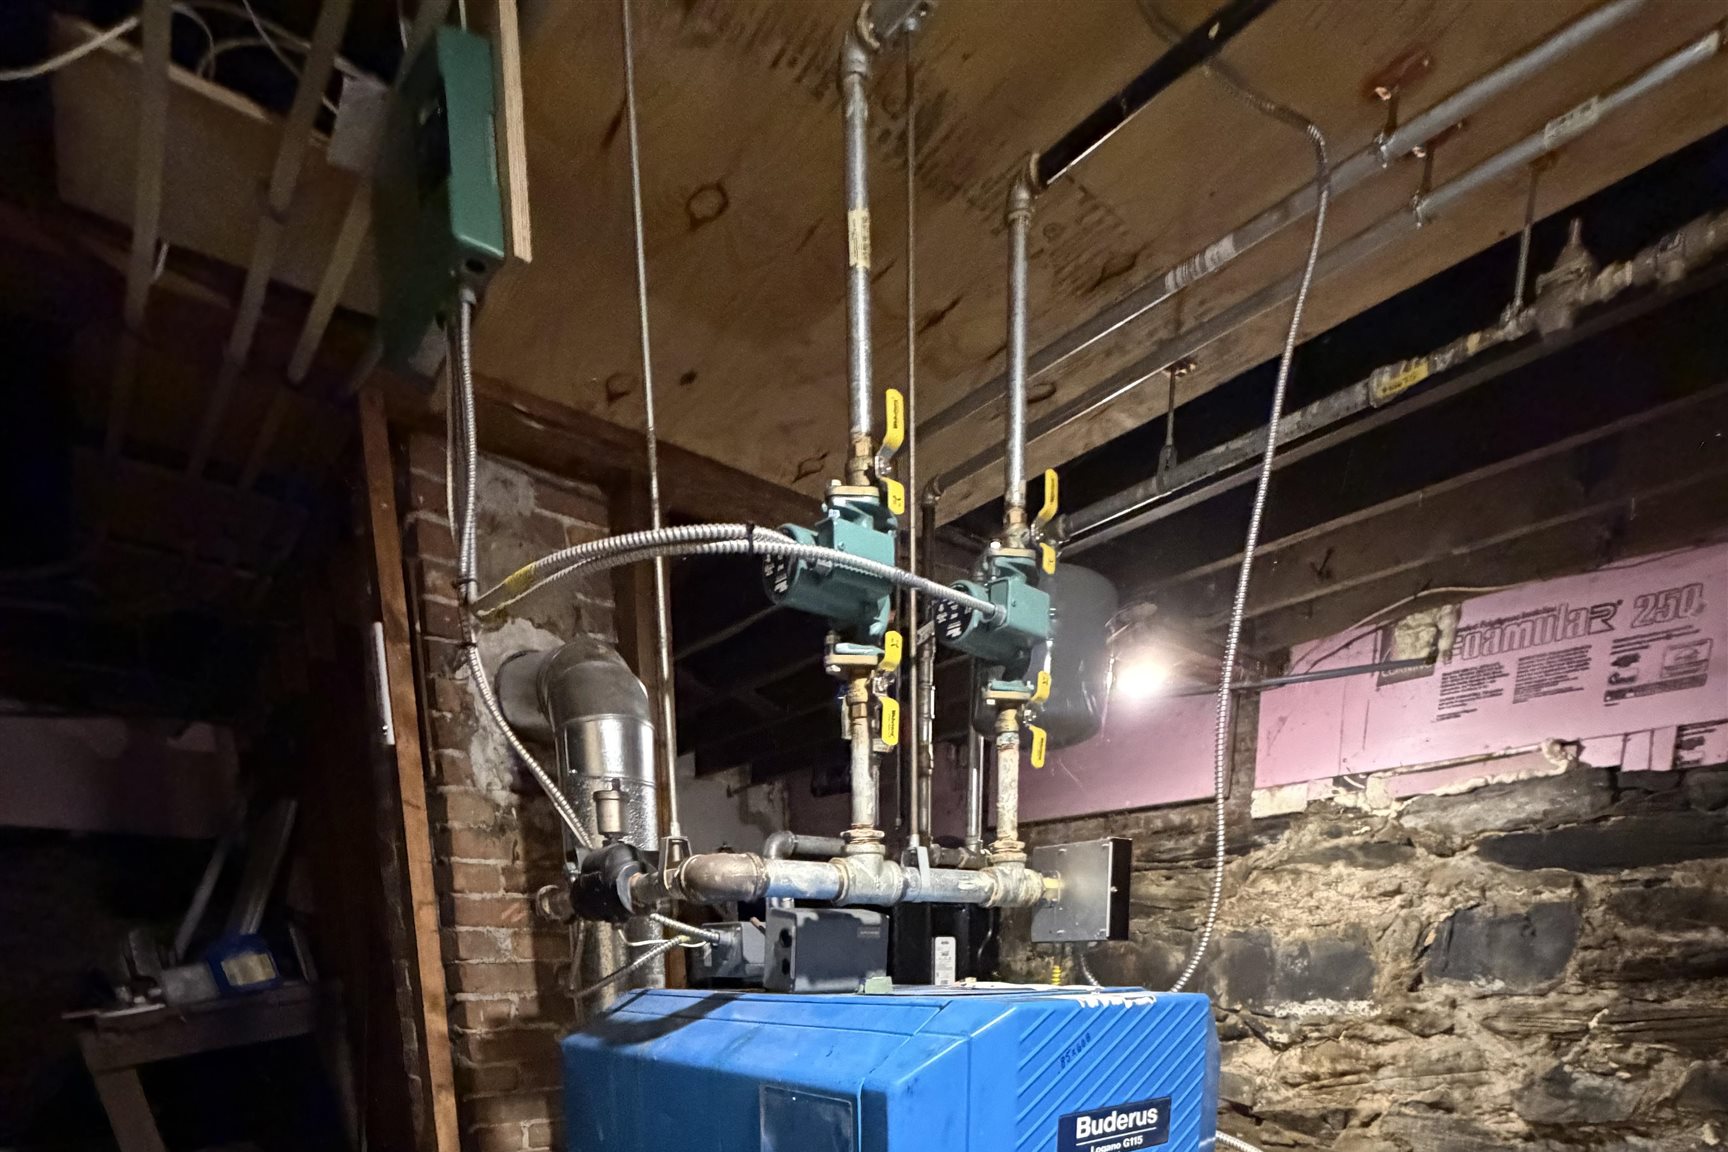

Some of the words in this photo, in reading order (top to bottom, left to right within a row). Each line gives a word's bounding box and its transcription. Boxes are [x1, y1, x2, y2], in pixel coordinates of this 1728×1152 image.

[1630, 583, 1704, 629] 250
[1075, 1107, 1158, 1139] Buderus
[1122, 1135, 1143, 1148] G115
